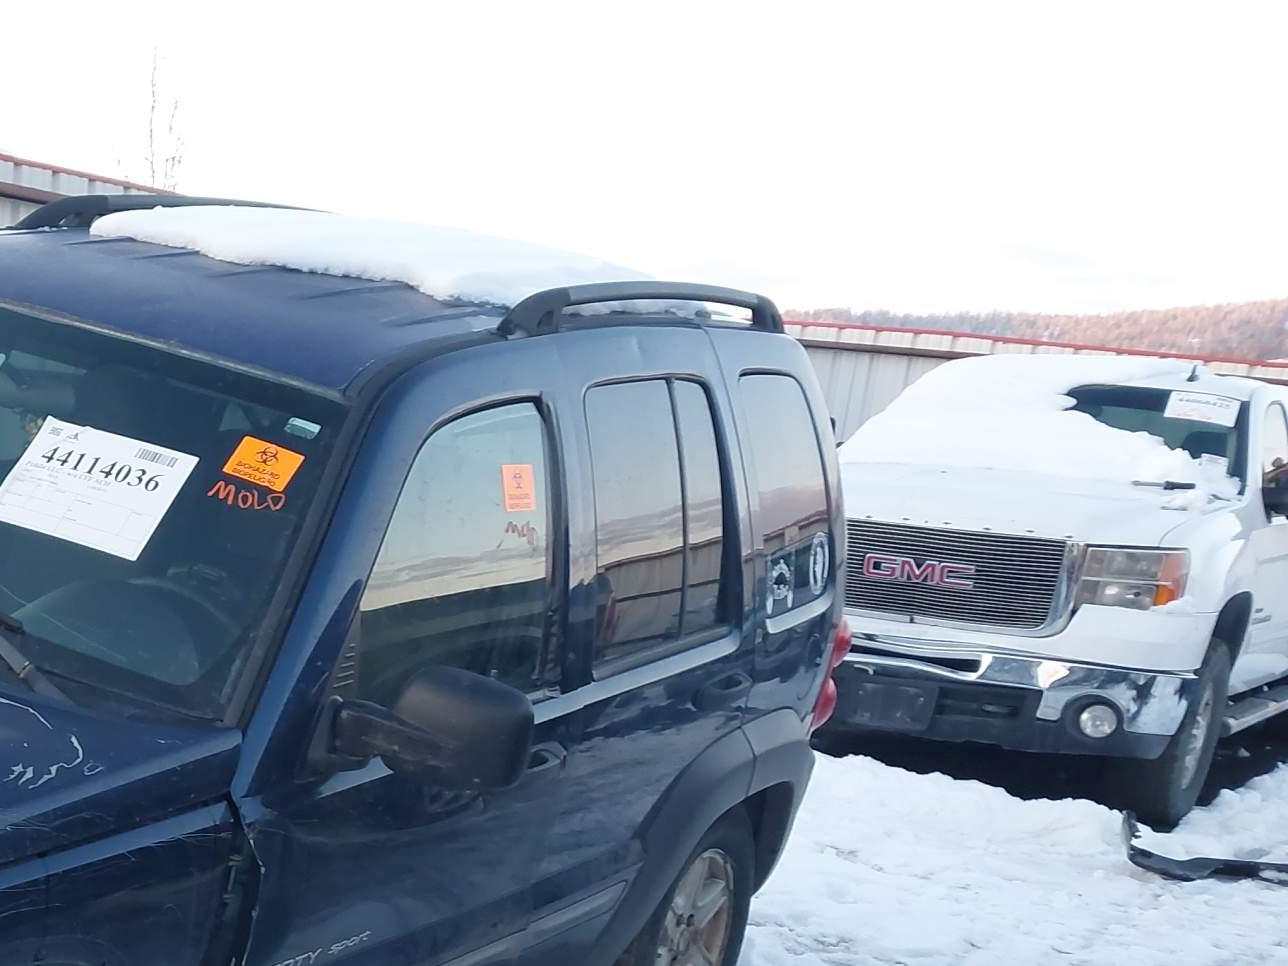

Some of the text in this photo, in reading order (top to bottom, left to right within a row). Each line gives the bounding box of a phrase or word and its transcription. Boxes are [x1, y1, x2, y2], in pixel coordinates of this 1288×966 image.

[41, 446, 165, 492] 44114036
[208, 480, 286, 511] MOLD
[863, 552, 976, 589] GMC
